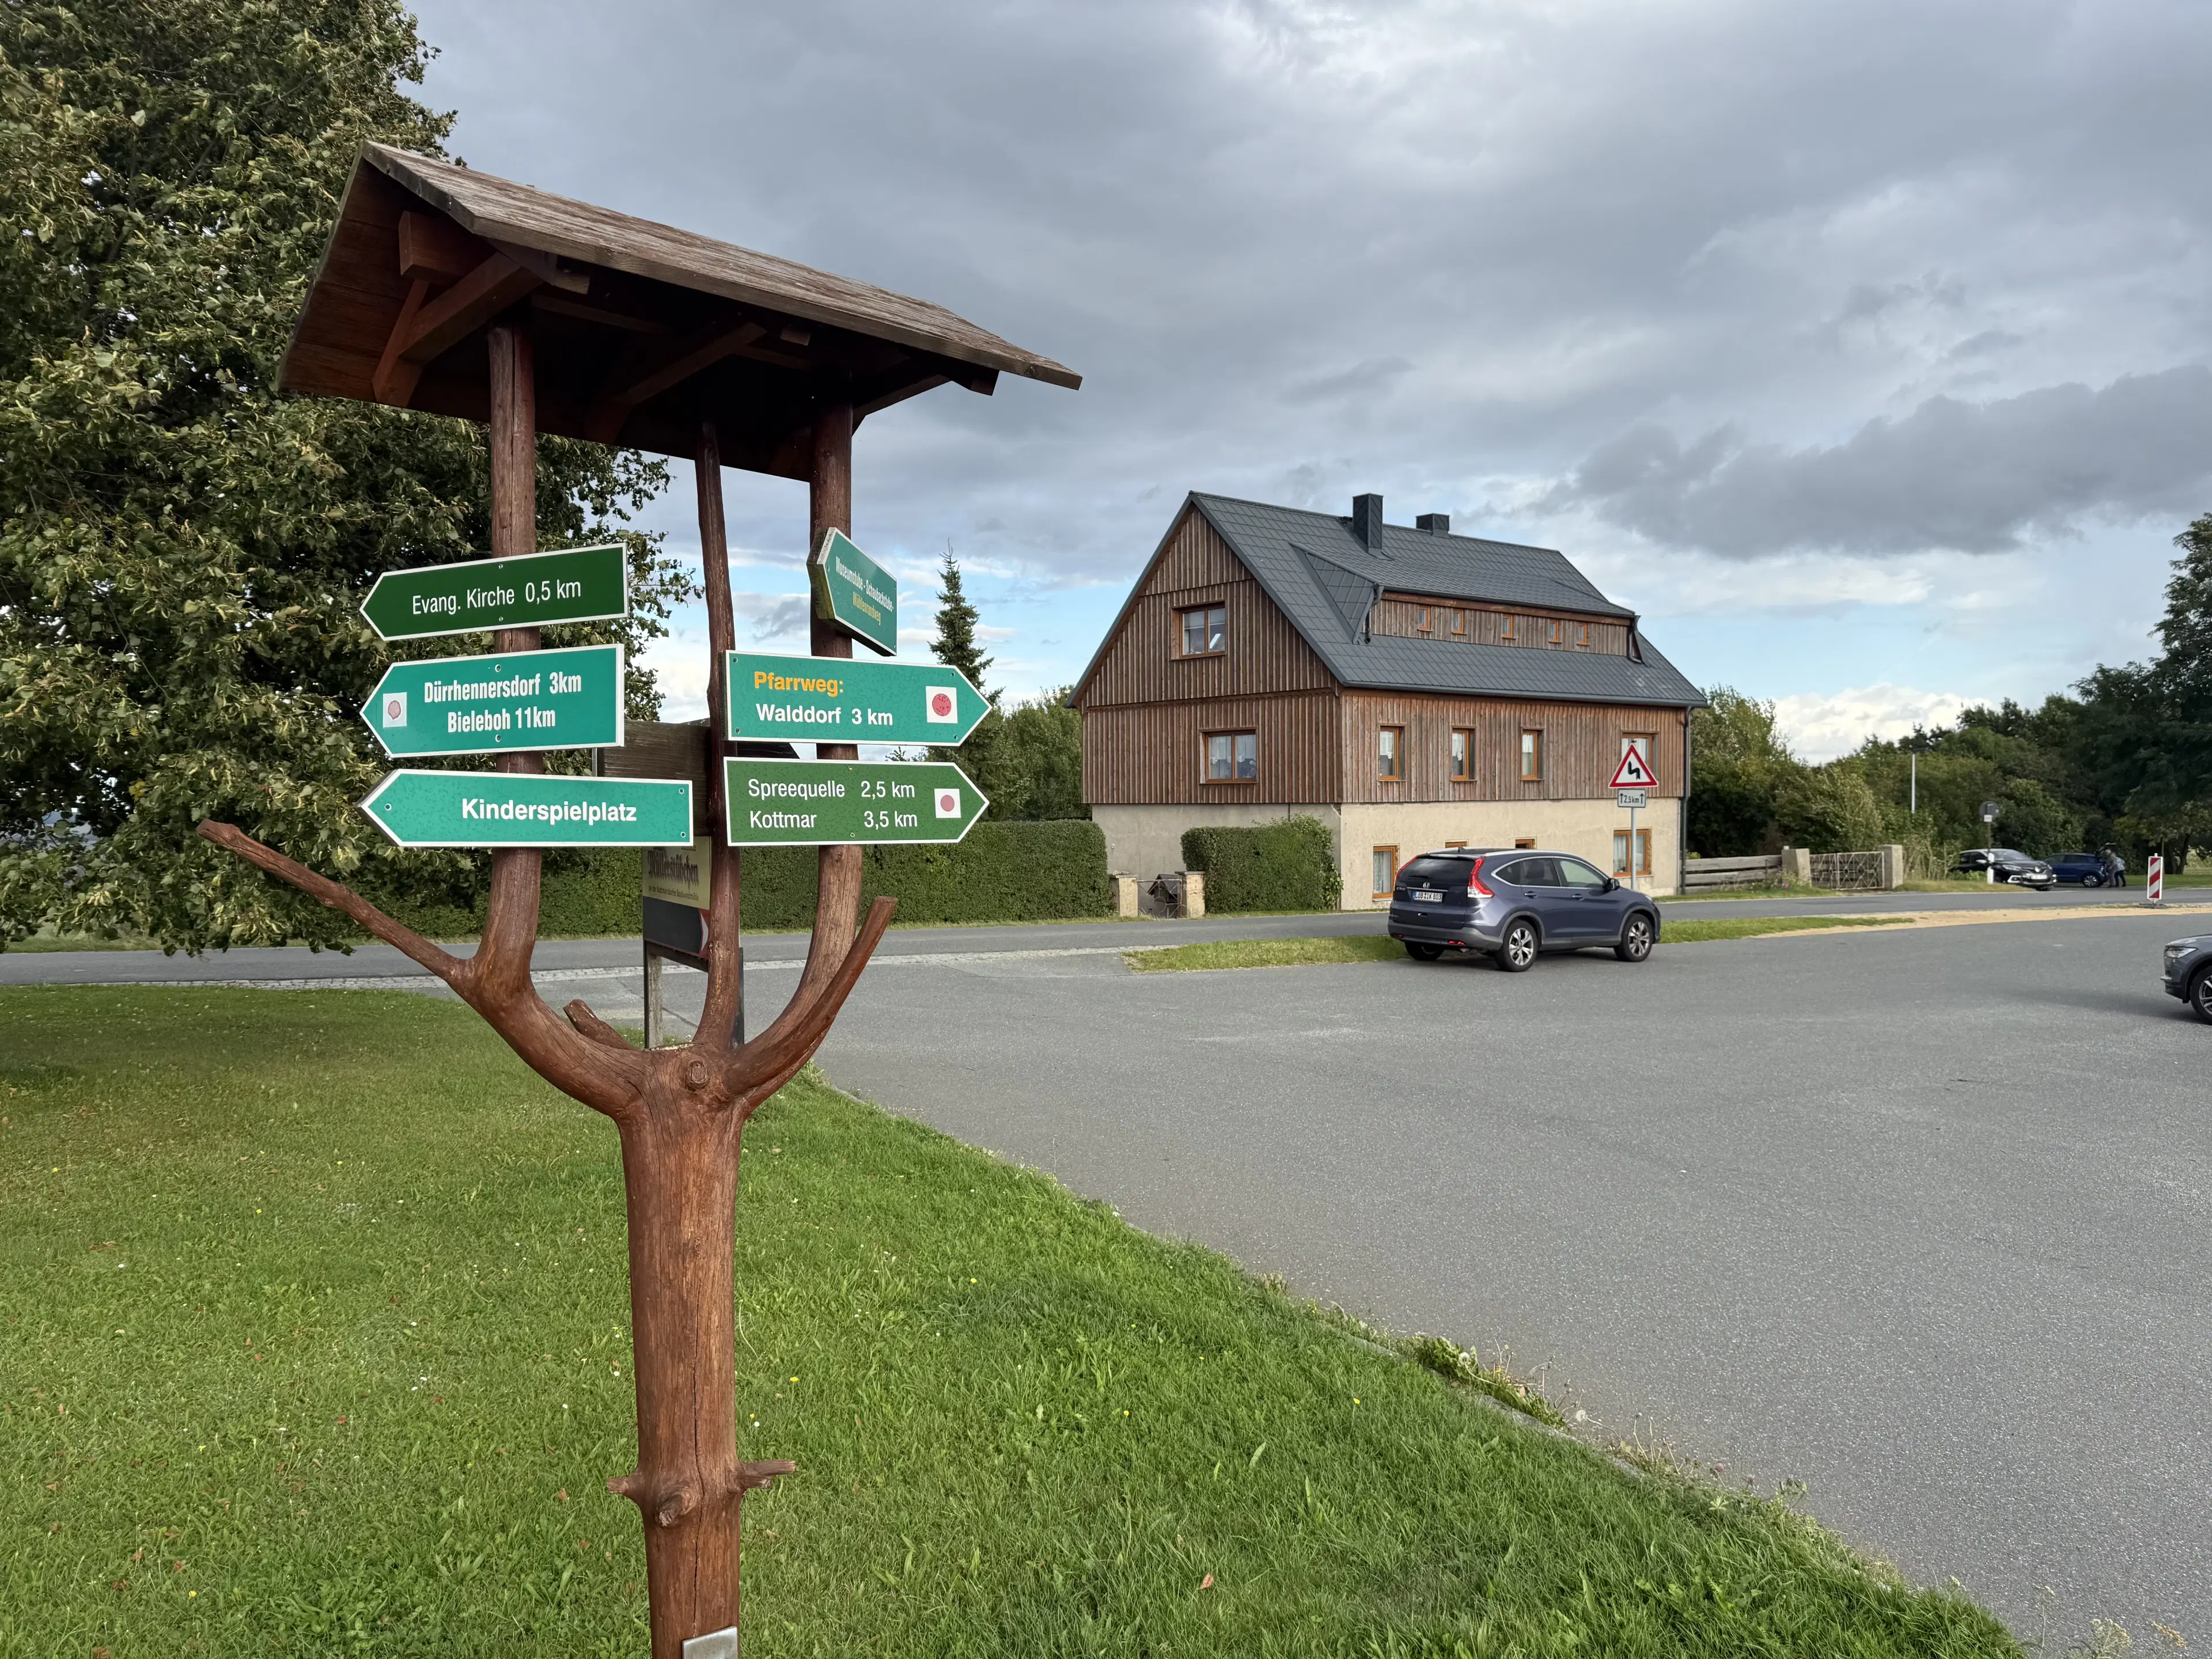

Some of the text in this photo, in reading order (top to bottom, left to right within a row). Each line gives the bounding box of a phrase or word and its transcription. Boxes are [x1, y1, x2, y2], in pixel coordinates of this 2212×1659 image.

[413, 579, 581, 615] Evang. Kirche 0,5 km
[425, 672, 581, 702] Dürrhennersdorf 3km
[755, 672, 843, 697] Pfarrweg:
[448, 706, 555, 732] Bieleboh 11km
[756, 704, 892, 725] Walddorf 3 km
[749, 779, 915, 800] Spreequelle 2,5 km
[463, 798, 637, 825] Kinderspielplatz
[751, 811, 917, 830] Kottmar 3,5 km
